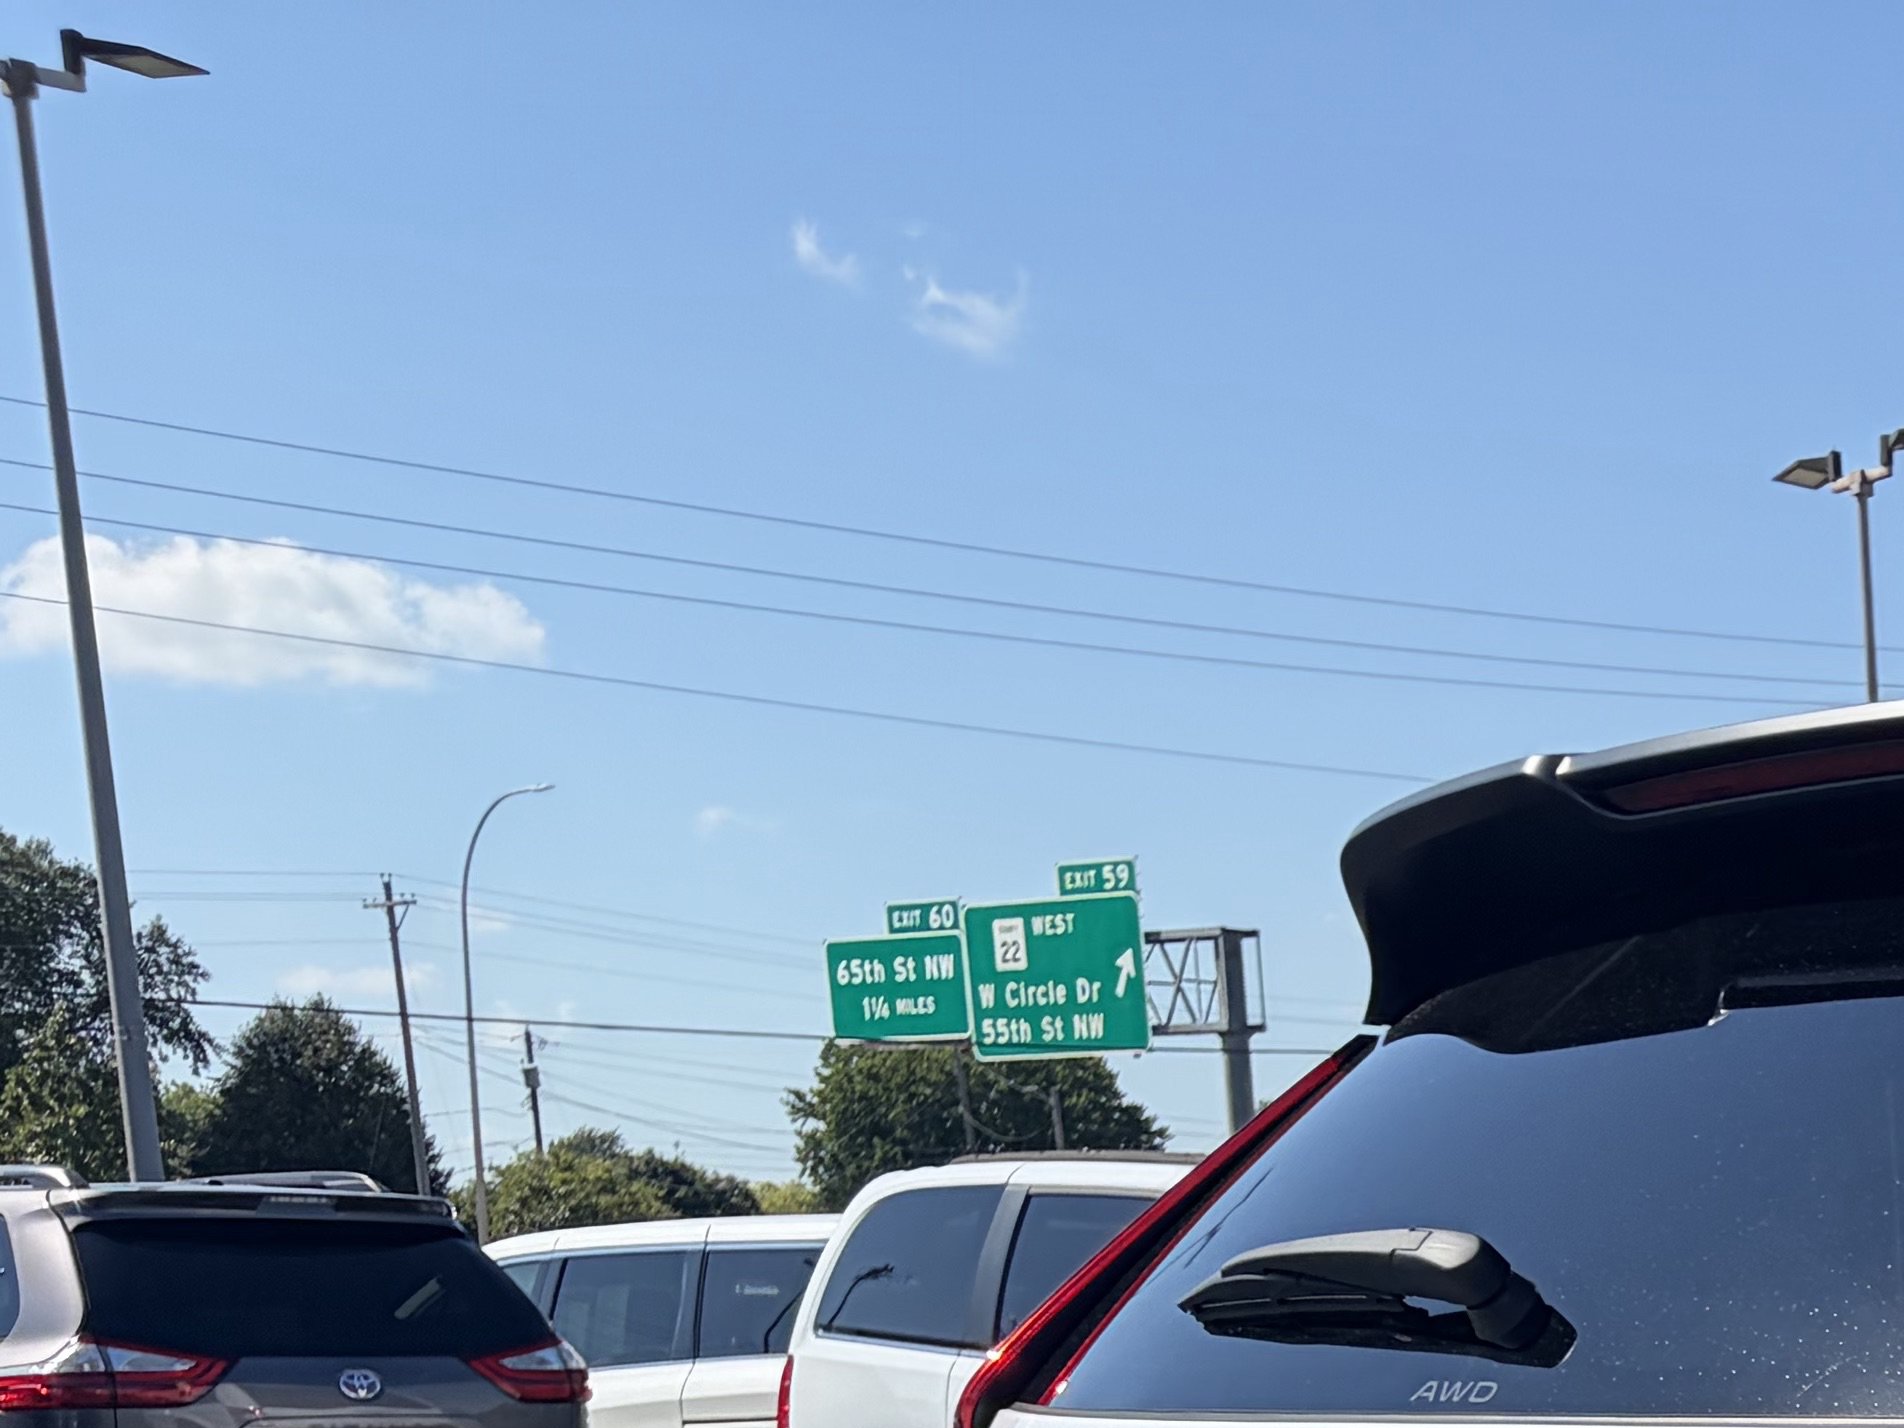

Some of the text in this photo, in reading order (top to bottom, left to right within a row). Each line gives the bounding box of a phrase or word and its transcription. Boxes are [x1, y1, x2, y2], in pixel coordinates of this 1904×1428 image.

[1064, 864, 1129, 890] EXIT 59
[892, 904, 955, 929] EXIT 60
[1031, 913, 1075, 936] WEST
[1000, 940, 1021, 964] 22
[837, 953, 955, 986] 65th St NW
[978, 977, 1101, 1009] W Circle Dr
[896, 996, 936, 1016] MILES
[982, 1013, 1104, 1045] 55th St NW
[1409, 1381, 1498, 1403] AWD
